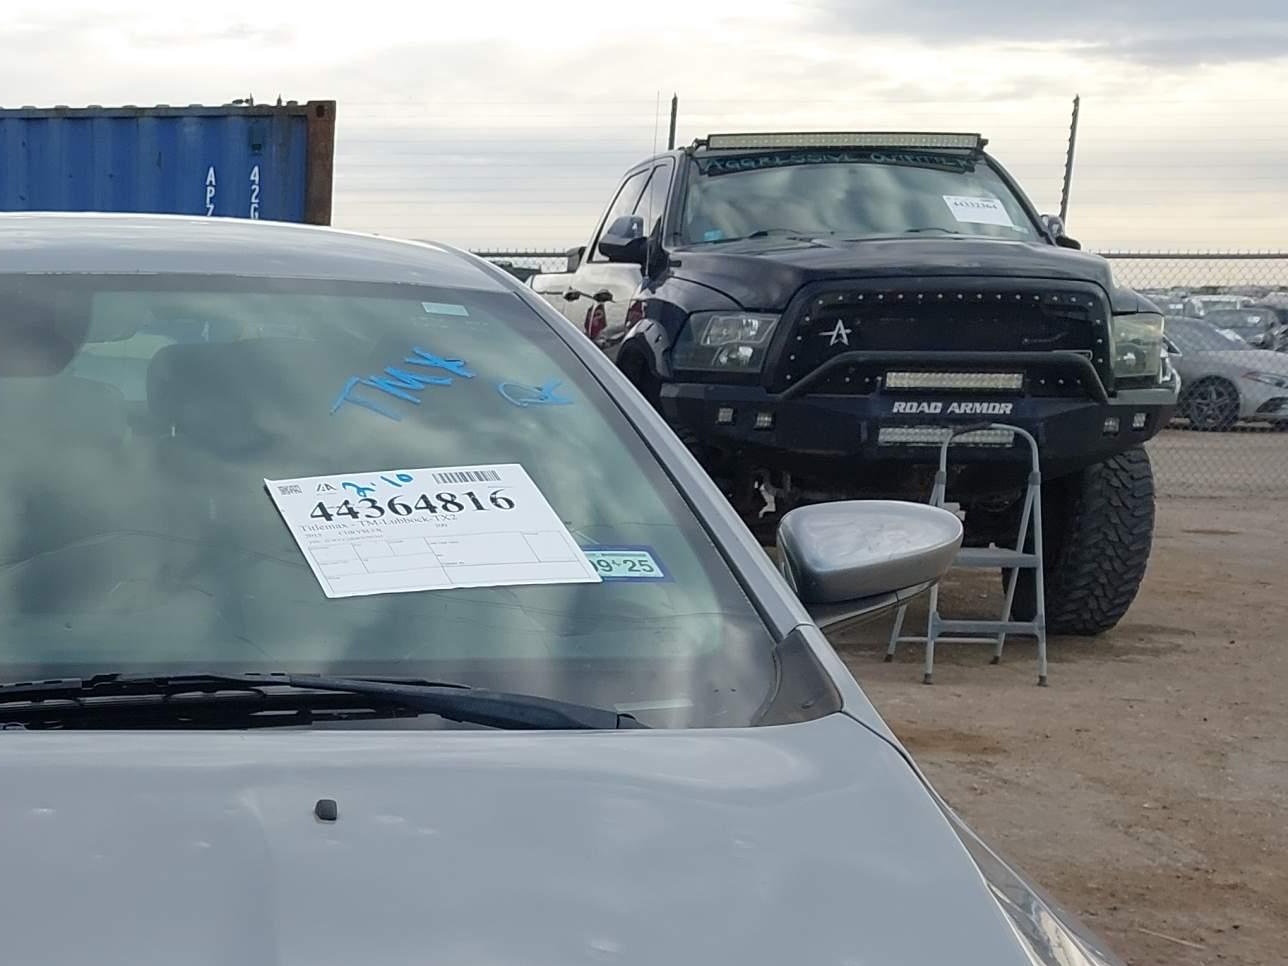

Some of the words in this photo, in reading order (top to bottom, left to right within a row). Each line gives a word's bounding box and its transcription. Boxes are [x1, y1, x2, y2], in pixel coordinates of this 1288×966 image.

[892, 402, 943, 413] ROAD
[947, 402, 1013, 414] ARMOR
[310, 489, 515, 521] 44364816
[623, 559, 654, 573] 25
